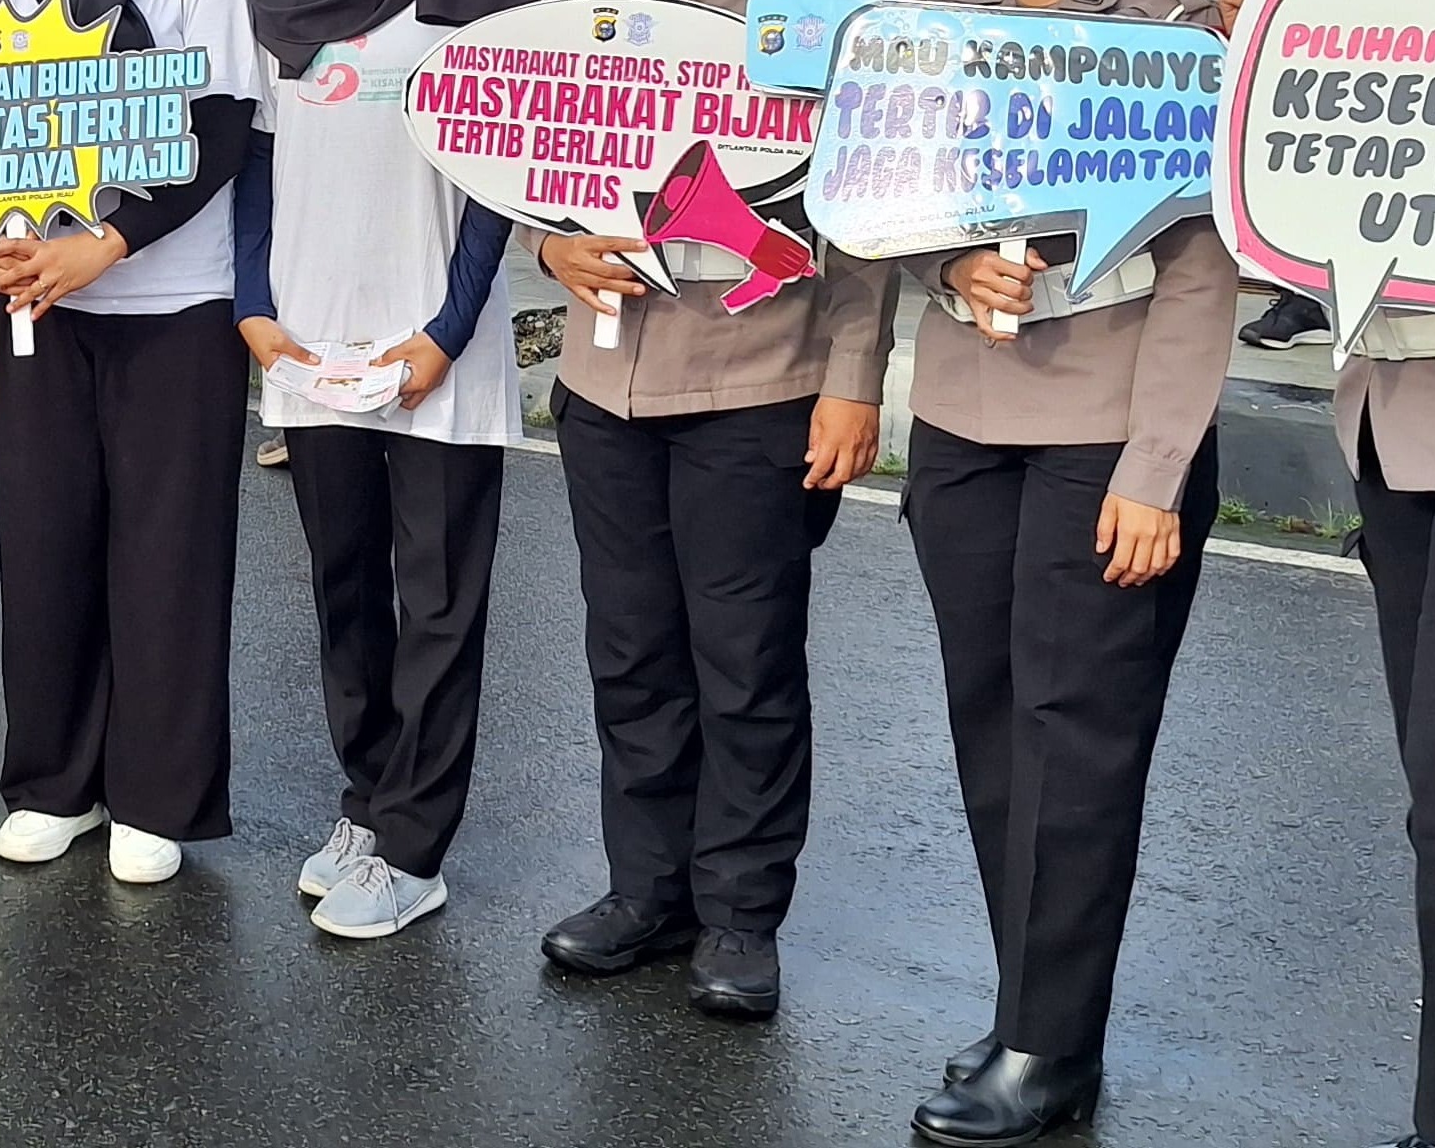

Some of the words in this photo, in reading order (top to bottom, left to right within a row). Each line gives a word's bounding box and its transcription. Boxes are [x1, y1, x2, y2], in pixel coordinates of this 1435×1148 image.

[37, 58, 118, 100] BURU
[124, 50, 207, 92] BURU
[444, 44, 580, 78] MASYARAKAT
[585, 54, 671, 89] CERDAS,
[676, 60, 732, 89] STOP
[849, 34, 950, 77] MAU
[963, 40, 1223, 93] KAMPANYE
[56, 93, 183, 147] TERTIB
[416, 72, 682, 132] MASYARAKAT
[692, 92, 816, 144] BIJAK
[833, 81, 991, 140] TERTIB
[1007, 92, 1053, 141] DI
[1069, 97, 1217, 142] JALAN
[102, 141, 191, 183] MAJU
[436, 117, 525, 157] TERTIB
[531, 125, 655, 170] BERLALU
[1265, 131, 1425, 180] TETAP
[525, 168, 621, 210] LINTAS
[1359, 192, 1435, 247] UT
